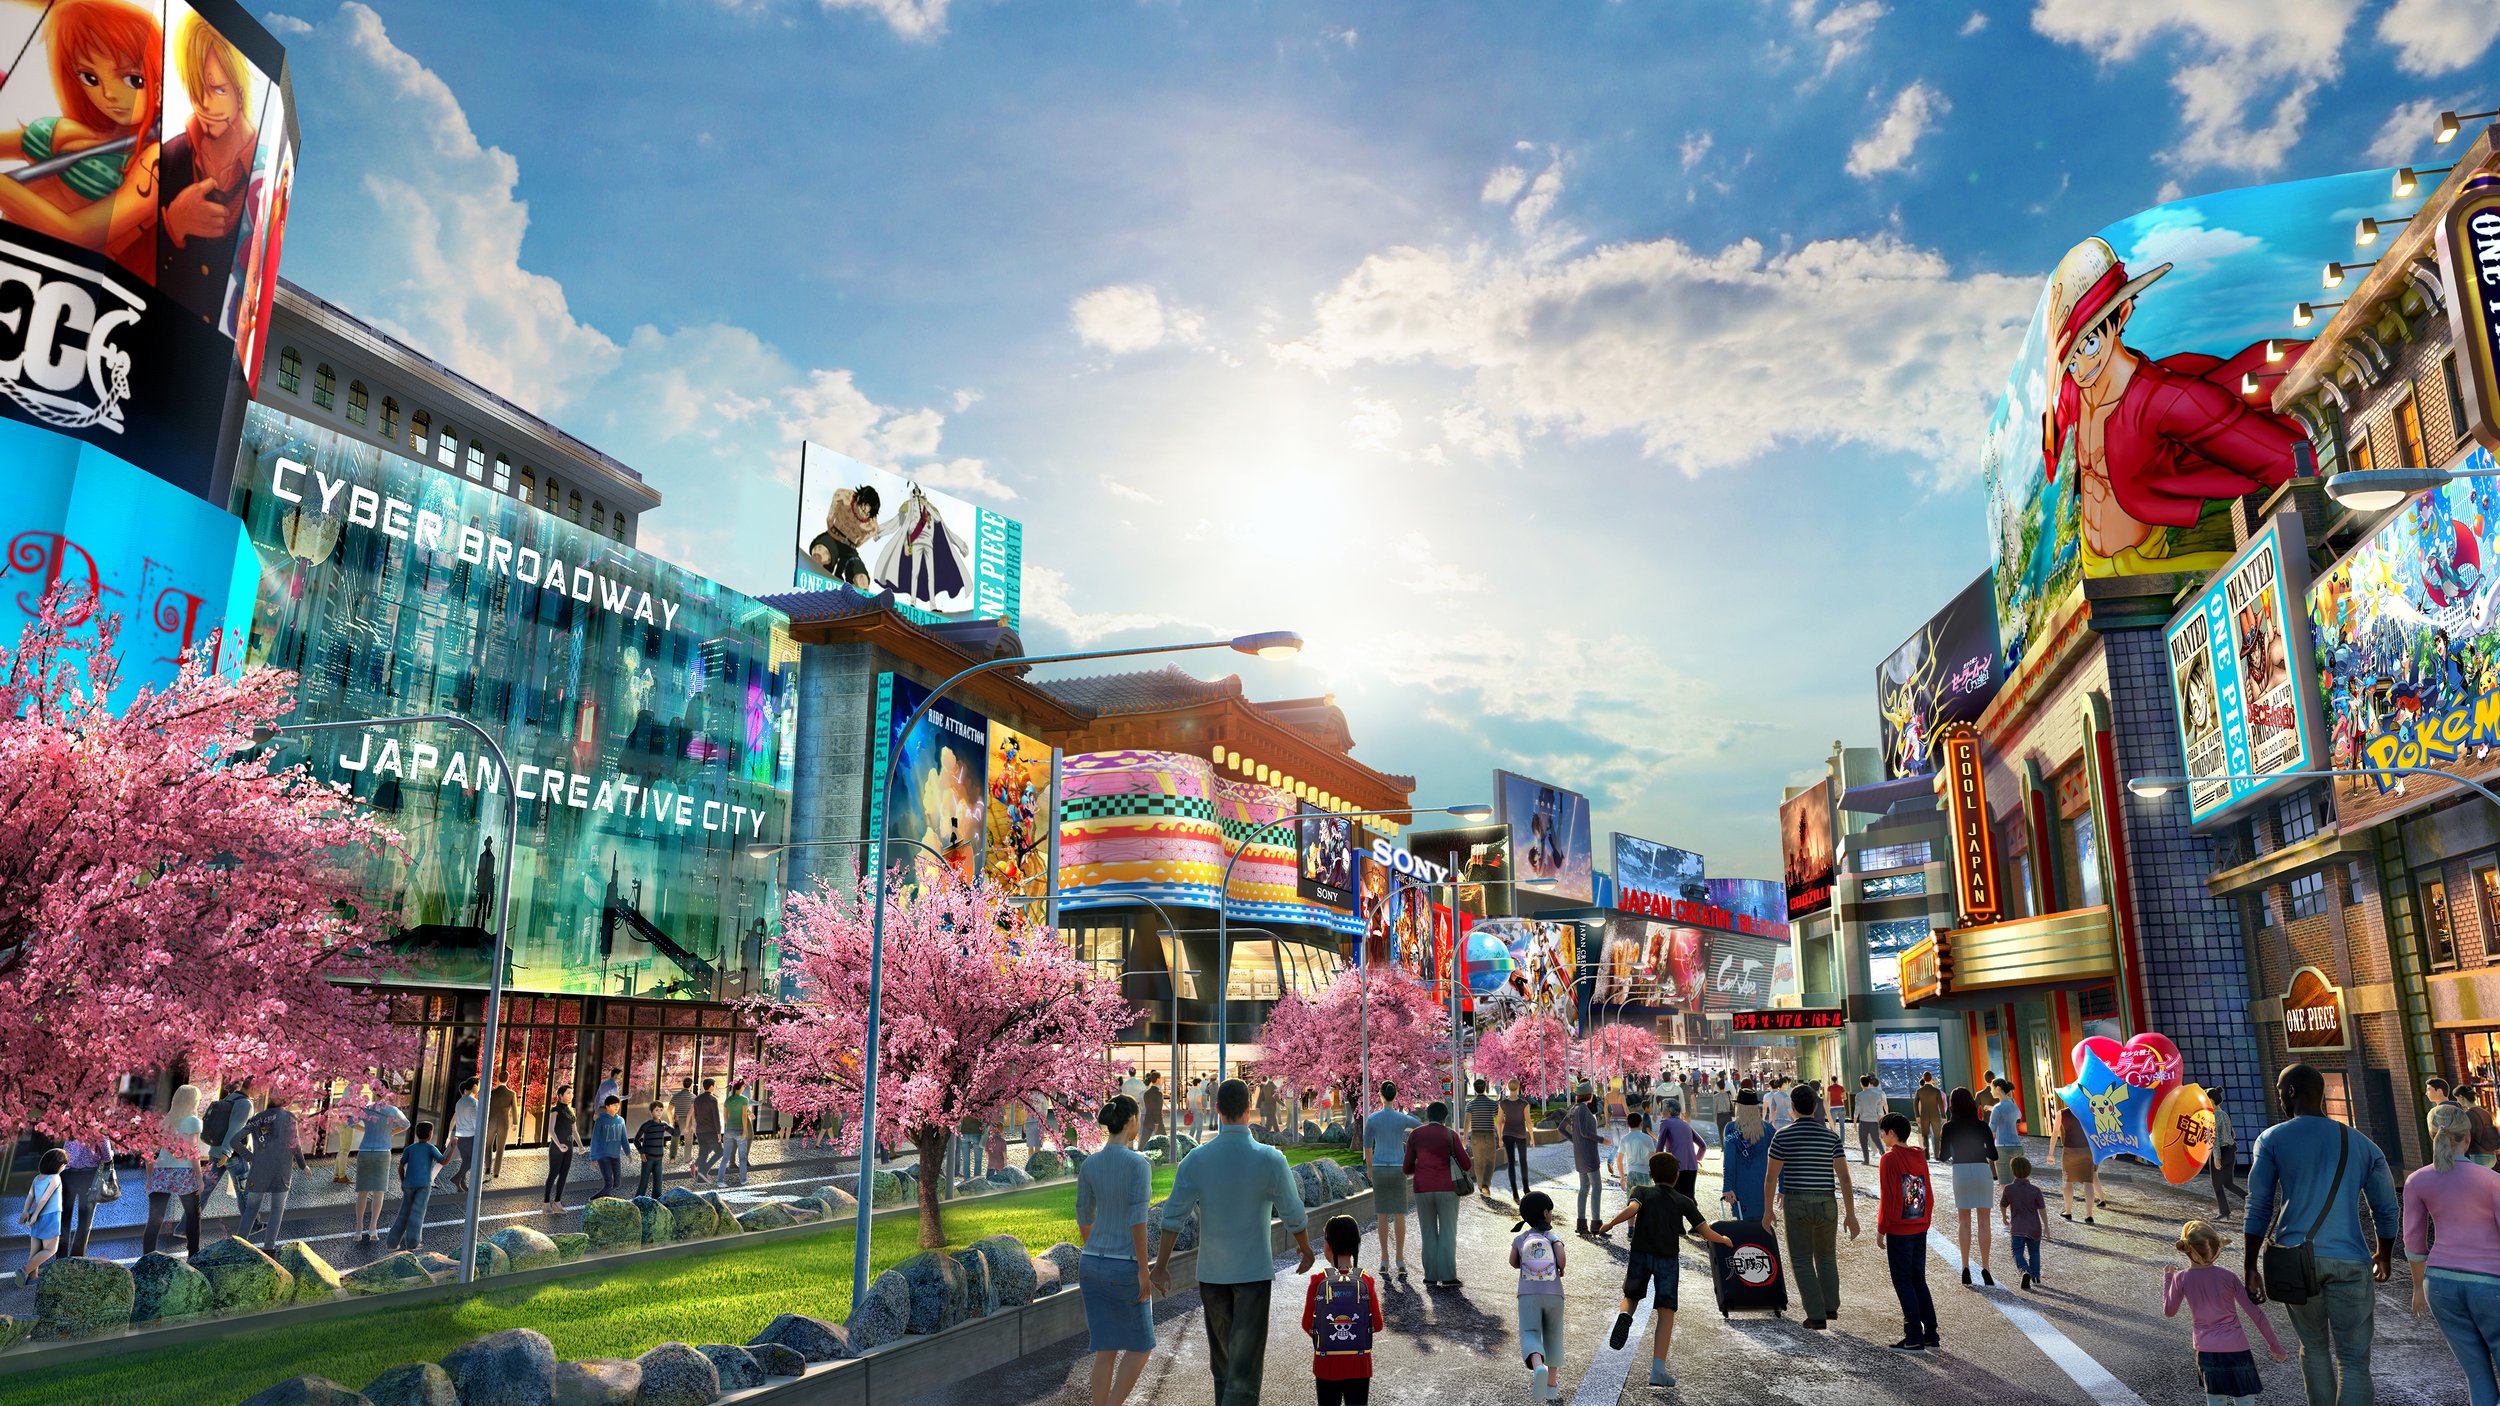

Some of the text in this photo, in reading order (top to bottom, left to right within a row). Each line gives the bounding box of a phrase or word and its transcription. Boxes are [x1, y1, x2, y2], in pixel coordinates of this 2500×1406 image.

[272, 457, 679, 631] CYBER BROADWAY
[980, 509, 1007, 583] PIECE
[1006, 521, 1020, 581] PIRATE
[2226, 547, 2274, 613] WANTED
[2171, 614, 2207, 667] WANTED
[875, 675, 891, 763] PIRATE
[2210, 593, 2250, 793] ONE PIECE
[2248, 704, 2295, 730] DECEASED
[929, 709, 985, 746] RIDE ATTRACTION
[339, 733, 500, 794] JAPAN
[516, 764, 694, 826] CREATIVE
[703, 800, 766, 838] CITY
[1960, 745, 1985, 903] COOL JAPAN
[1372, 838, 1449, 884] SONY
[1316, 887, 1338, 902] SONY
[1618, 887, 1672, 919] JAPAN
[1675, 900, 1733, 931] CREATIVE
[2286, 1005, 2337, 1032] ONE PIECE
